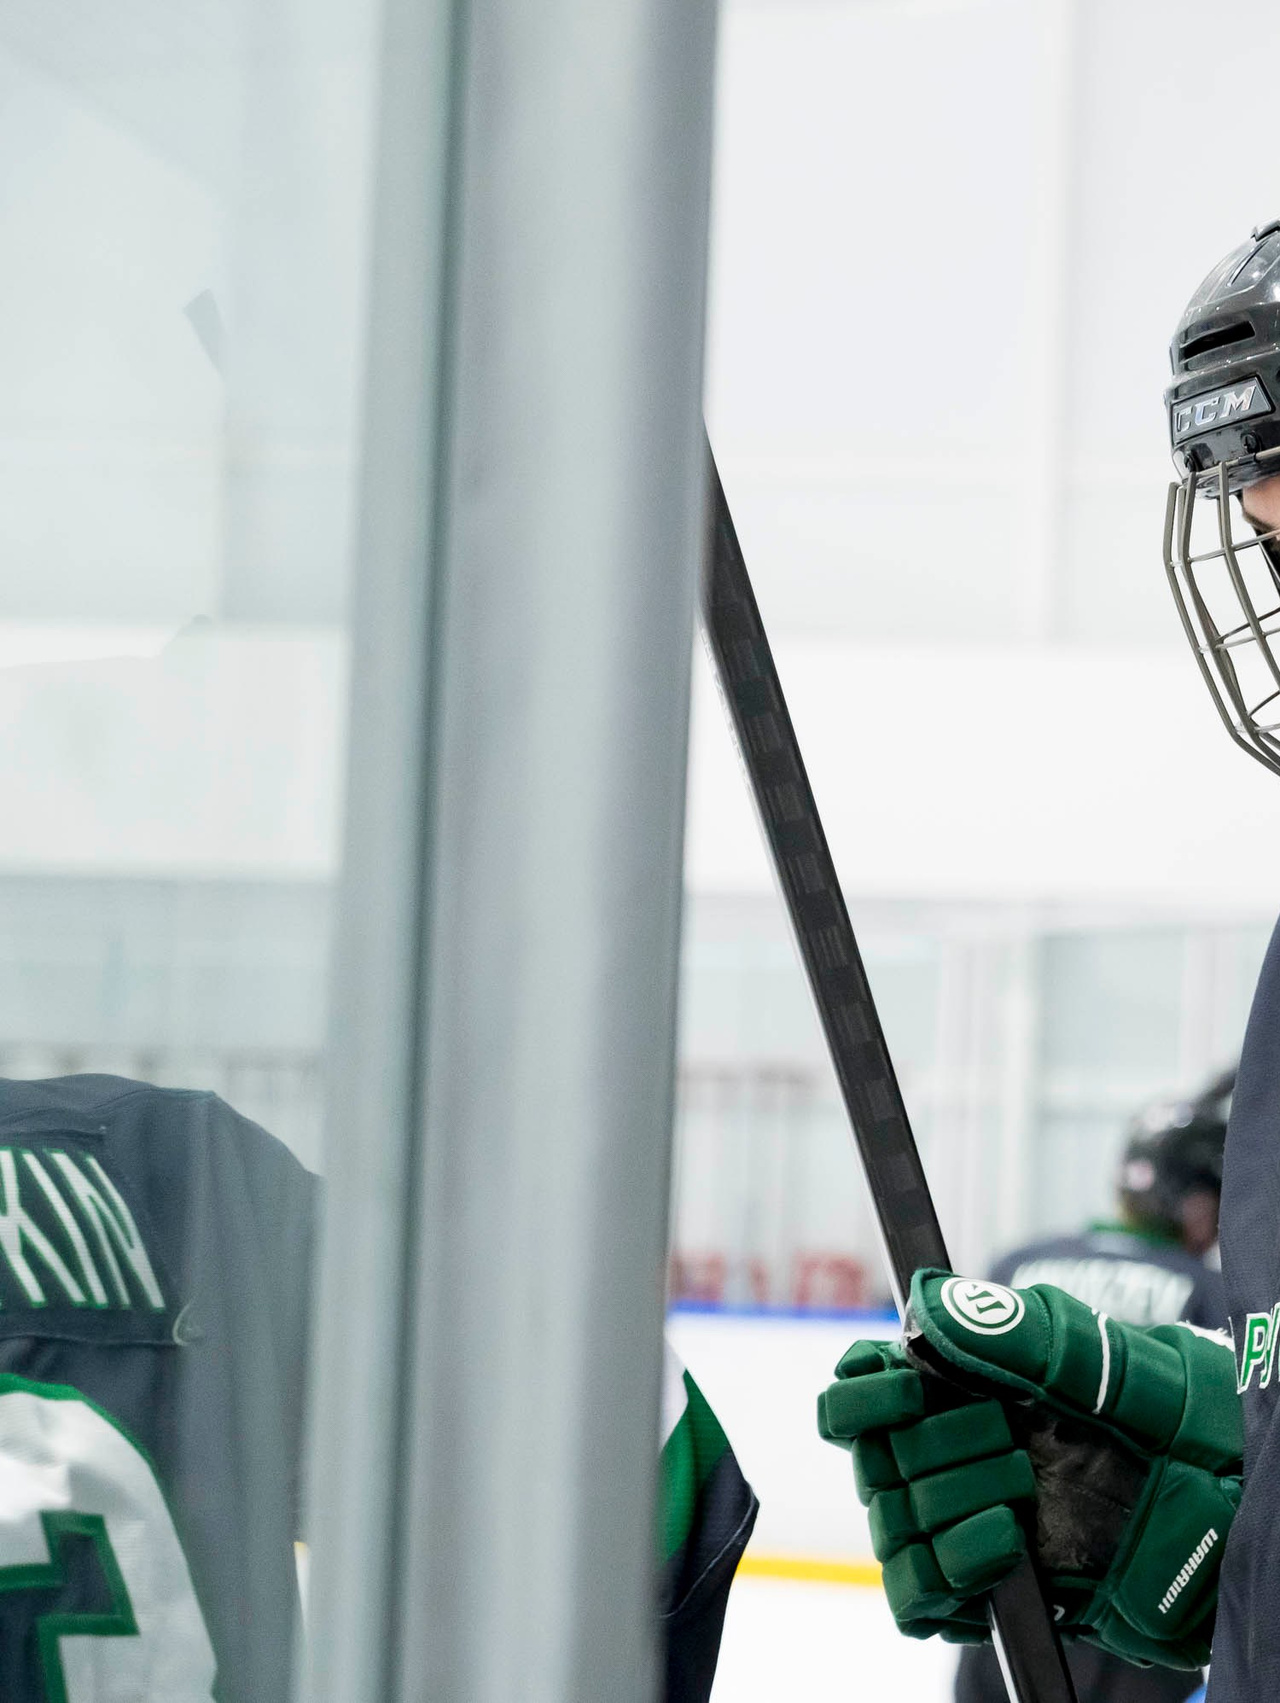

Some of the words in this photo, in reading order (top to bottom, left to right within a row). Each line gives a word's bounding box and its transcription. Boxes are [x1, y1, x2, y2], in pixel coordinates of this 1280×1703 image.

[1173, 384, 1258, 434] CCM
[0, 1146, 167, 1313] KIN
[1158, 1527, 1219, 1614] WARRIOR
